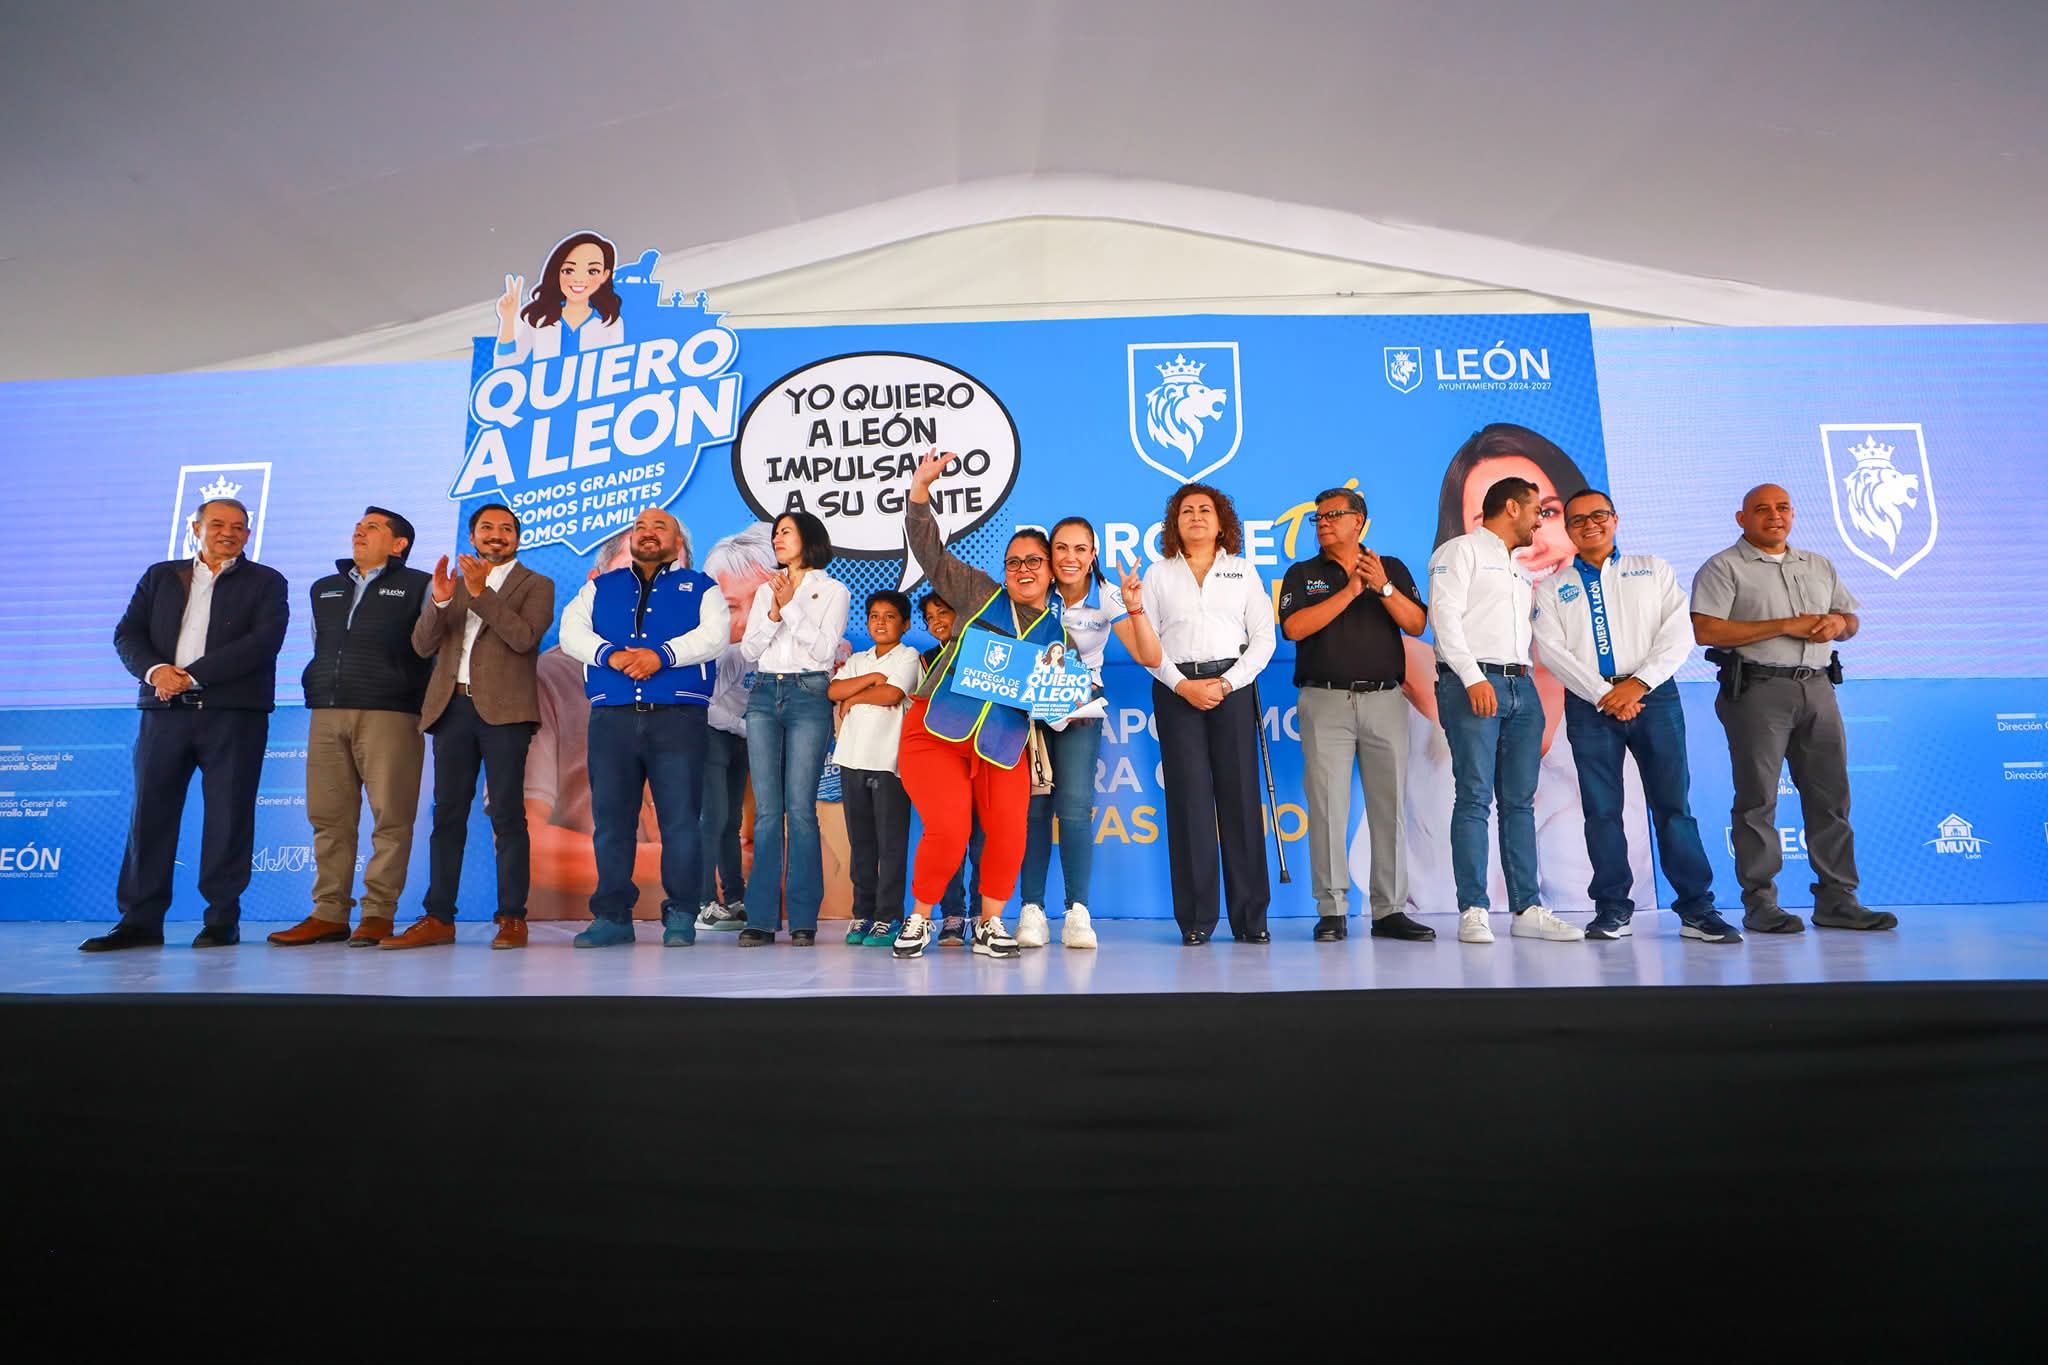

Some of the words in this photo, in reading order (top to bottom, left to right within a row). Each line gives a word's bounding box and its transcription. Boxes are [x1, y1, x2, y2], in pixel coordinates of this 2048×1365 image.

[1434, 340, 1551, 381] LEÓN
[475, 328, 733, 428] QUIERO
[1437, 382, 1507, 391] AYUNTAMIENTO
[1508, 382, 1552, 391] 2024-2027
[785, 383, 835, 414] YO
[842, 382, 975, 411] QUIERO
[453, 428, 516, 495] A
[527, 377, 737, 479] LEÓN
[808, 419, 833, 447] A
[841, 412, 937, 448] LEÓN
[765, 448, 991, 483] IMPULSADO
[512, 481, 576, 507] SOMOS
[580, 462, 666, 493] GRANDES
[581, 481, 663, 512] FUERTES
[785, 490, 806, 513] A
[816, 490, 865, 518] SU
[519, 519, 578, 545] OMOS
[1588, 580, 1602, 605] LEÓN
[1592, 605, 1604, 614] A
[1595, 615, 1610, 656] QUIERO
[960, 675, 1019, 699] APOYOS
[963, 667, 1007, 684] ENTREGA
[1008, 678, 1022, 688] DE
[1027, 672, 1091, 688] QUIERO
[1020, 687, 1037, 702] A
[1039, 687, 1090, 702] LEÓN
[1998, 721, 2042, 731] Dirección
[27, 752, 61, 761] General
[62, 752, 74, 761] de
[31, 761, 57, 771] Social
[20, 799, 54, 808] General
[56, 798, 68, 808] de
[25, 808, 49, 817] Rural
[256, 796, 292, 805] General
[293, 796, 305, 805] de
[1936, 841, 1982, 854] IMUVI
